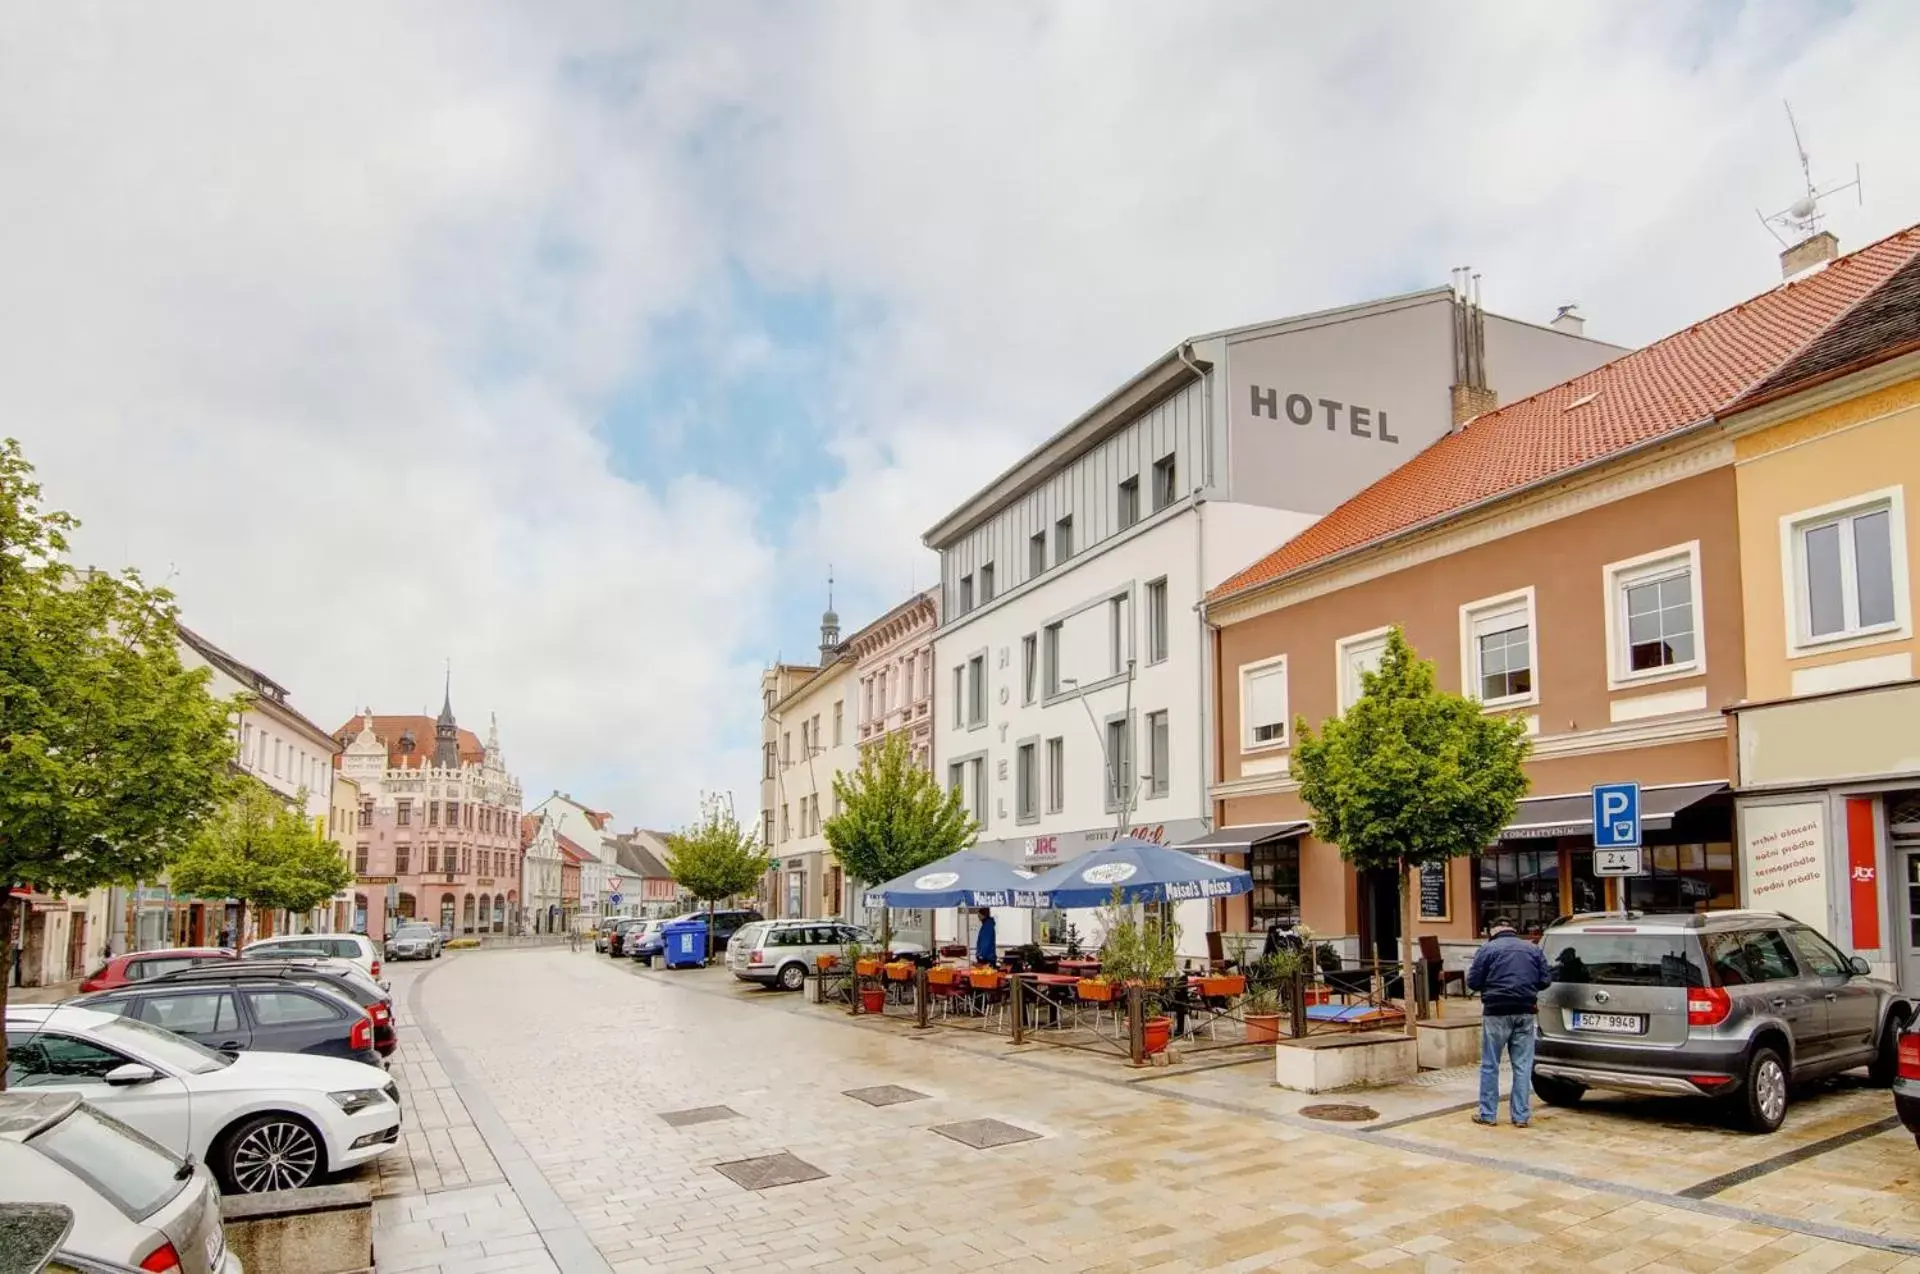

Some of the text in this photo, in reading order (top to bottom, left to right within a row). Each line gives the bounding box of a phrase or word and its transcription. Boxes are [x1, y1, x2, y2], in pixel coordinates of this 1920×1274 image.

[1250, 385, 1399, 444] HOTEL
[997, 645, 1010, 819] HOTEL
[1603, 792, 1628, 829] P
[1033, 836, 1057, 854] JRC
[1607, 852, 1615, 863] 2
[1582, 1014, 1636, 1029] 5C7 9948
